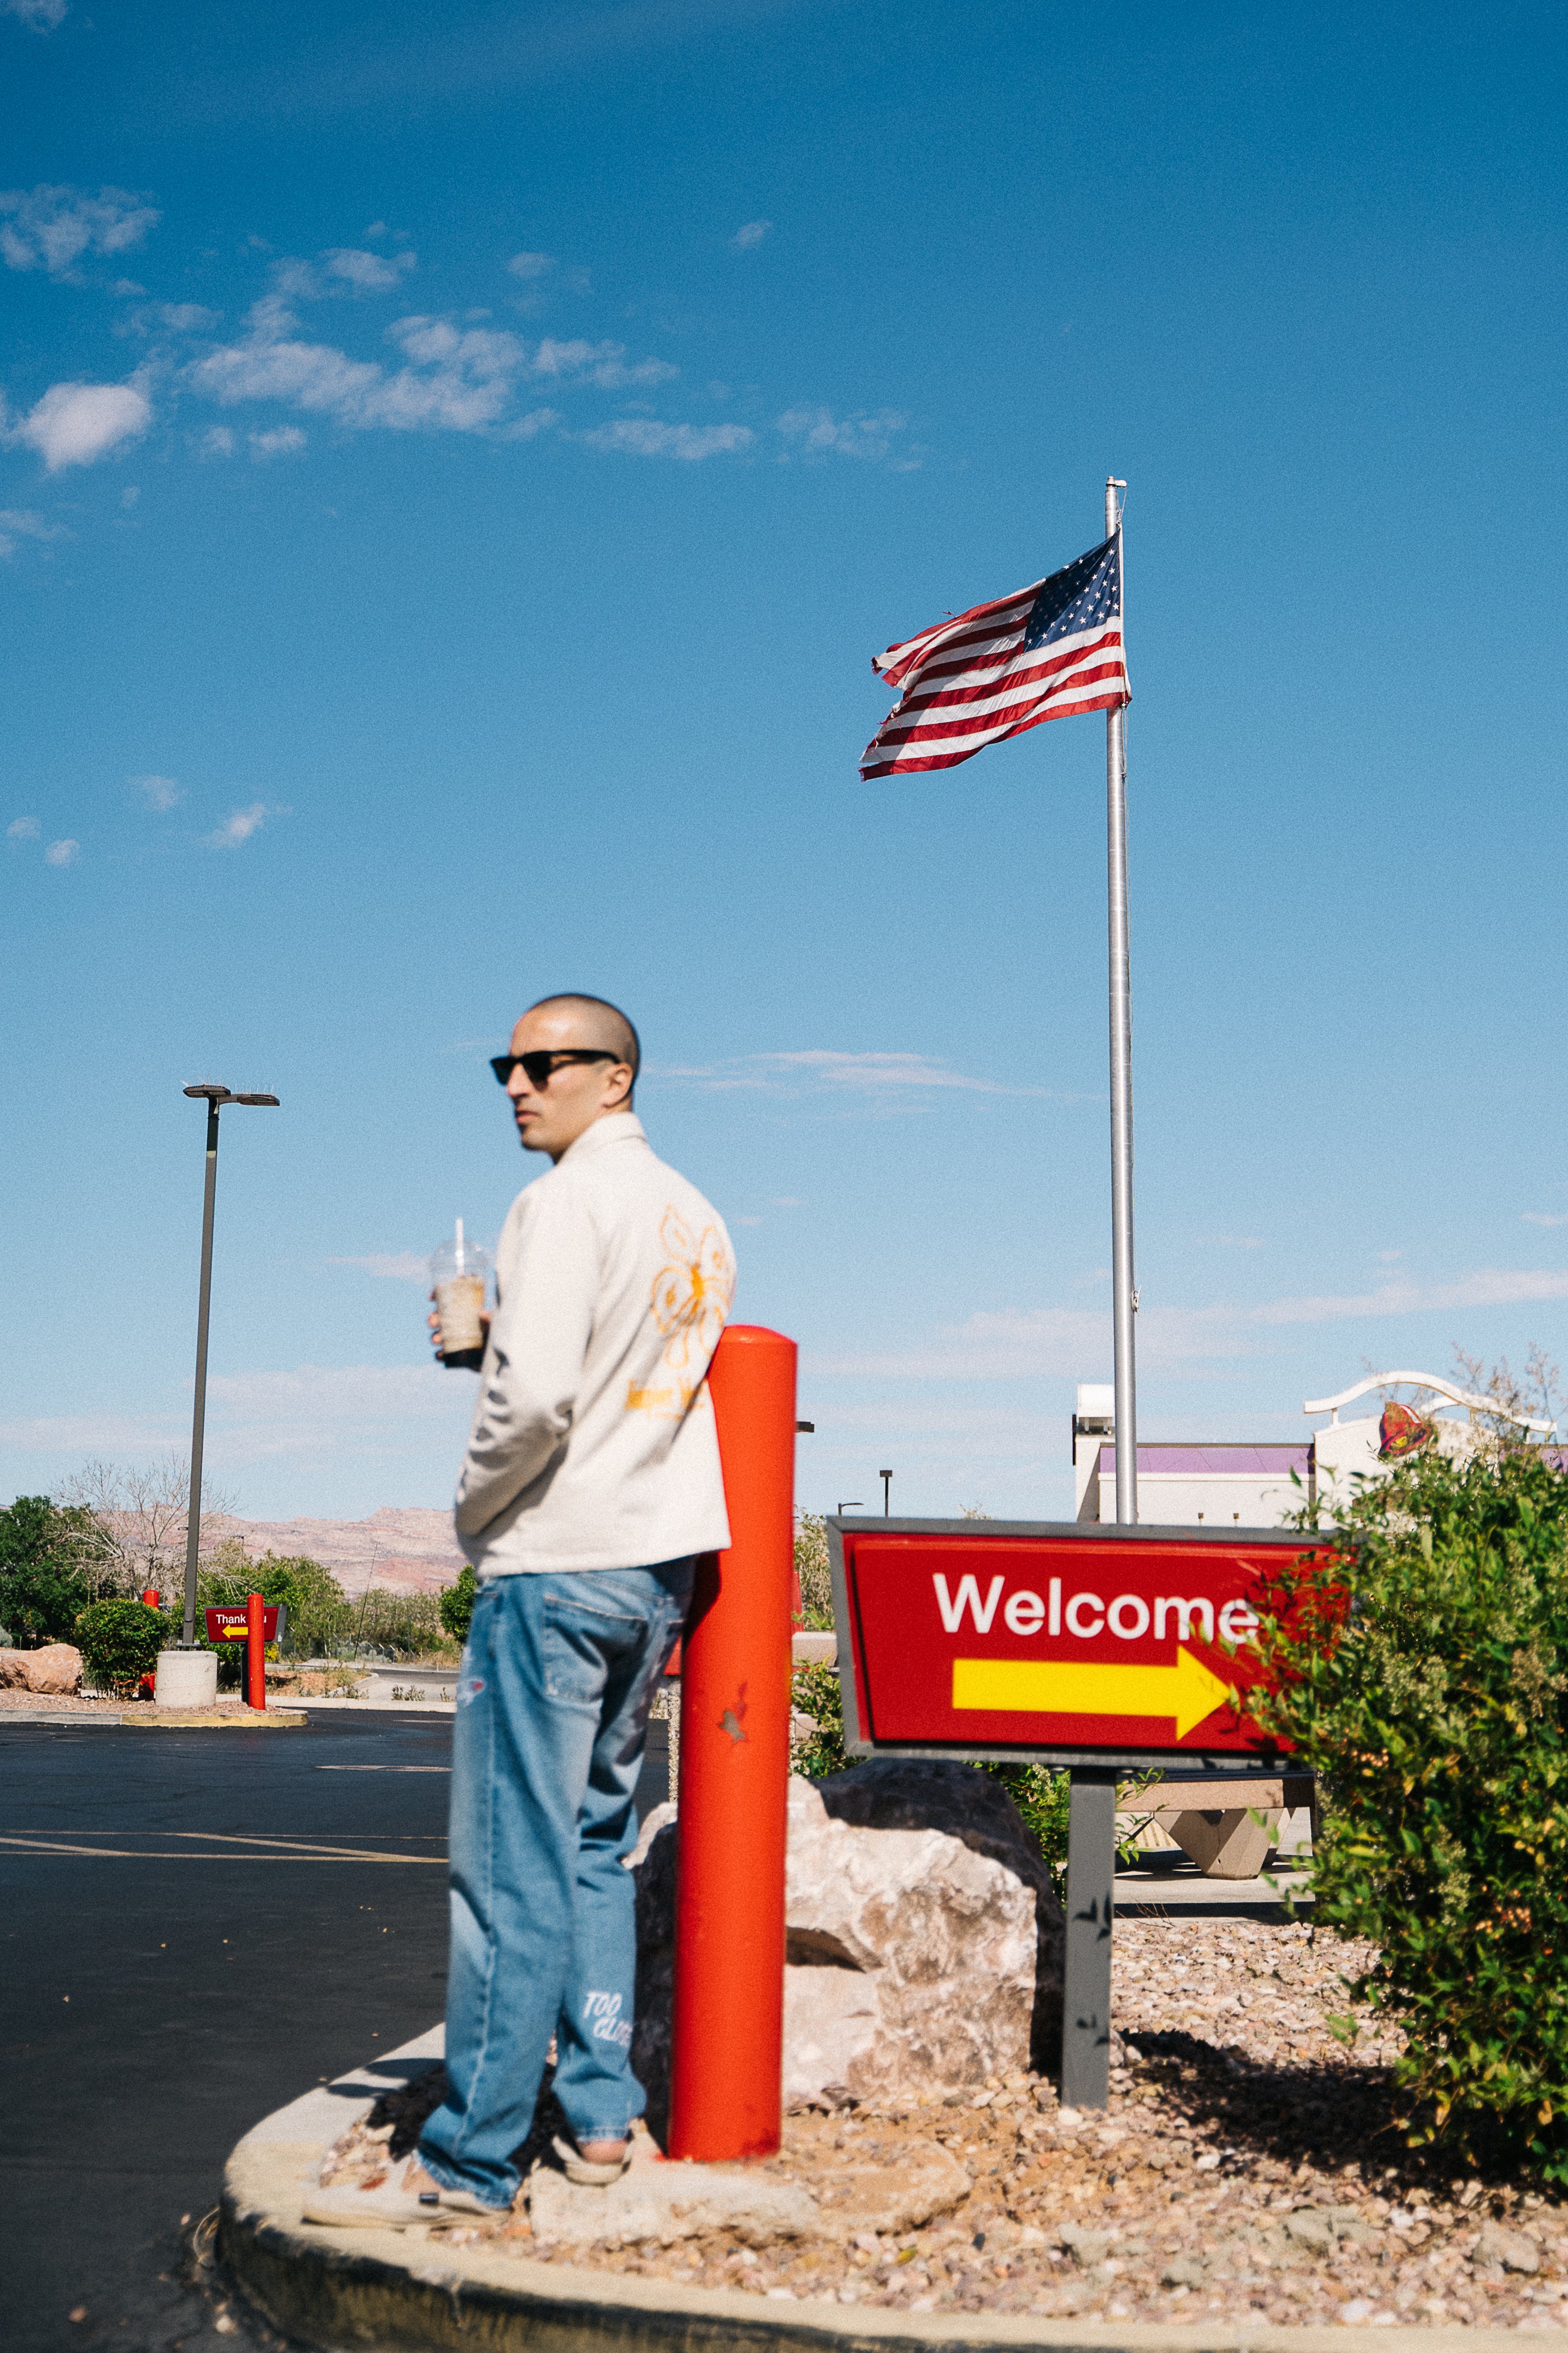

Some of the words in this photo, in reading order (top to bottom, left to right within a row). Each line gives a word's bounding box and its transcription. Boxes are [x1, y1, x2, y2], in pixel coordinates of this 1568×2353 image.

[216, 1613, 246, 1624] Thank
[932, 1573, 1260, 1644] Welcome
[582, 1990, 622, 2019] TOO
